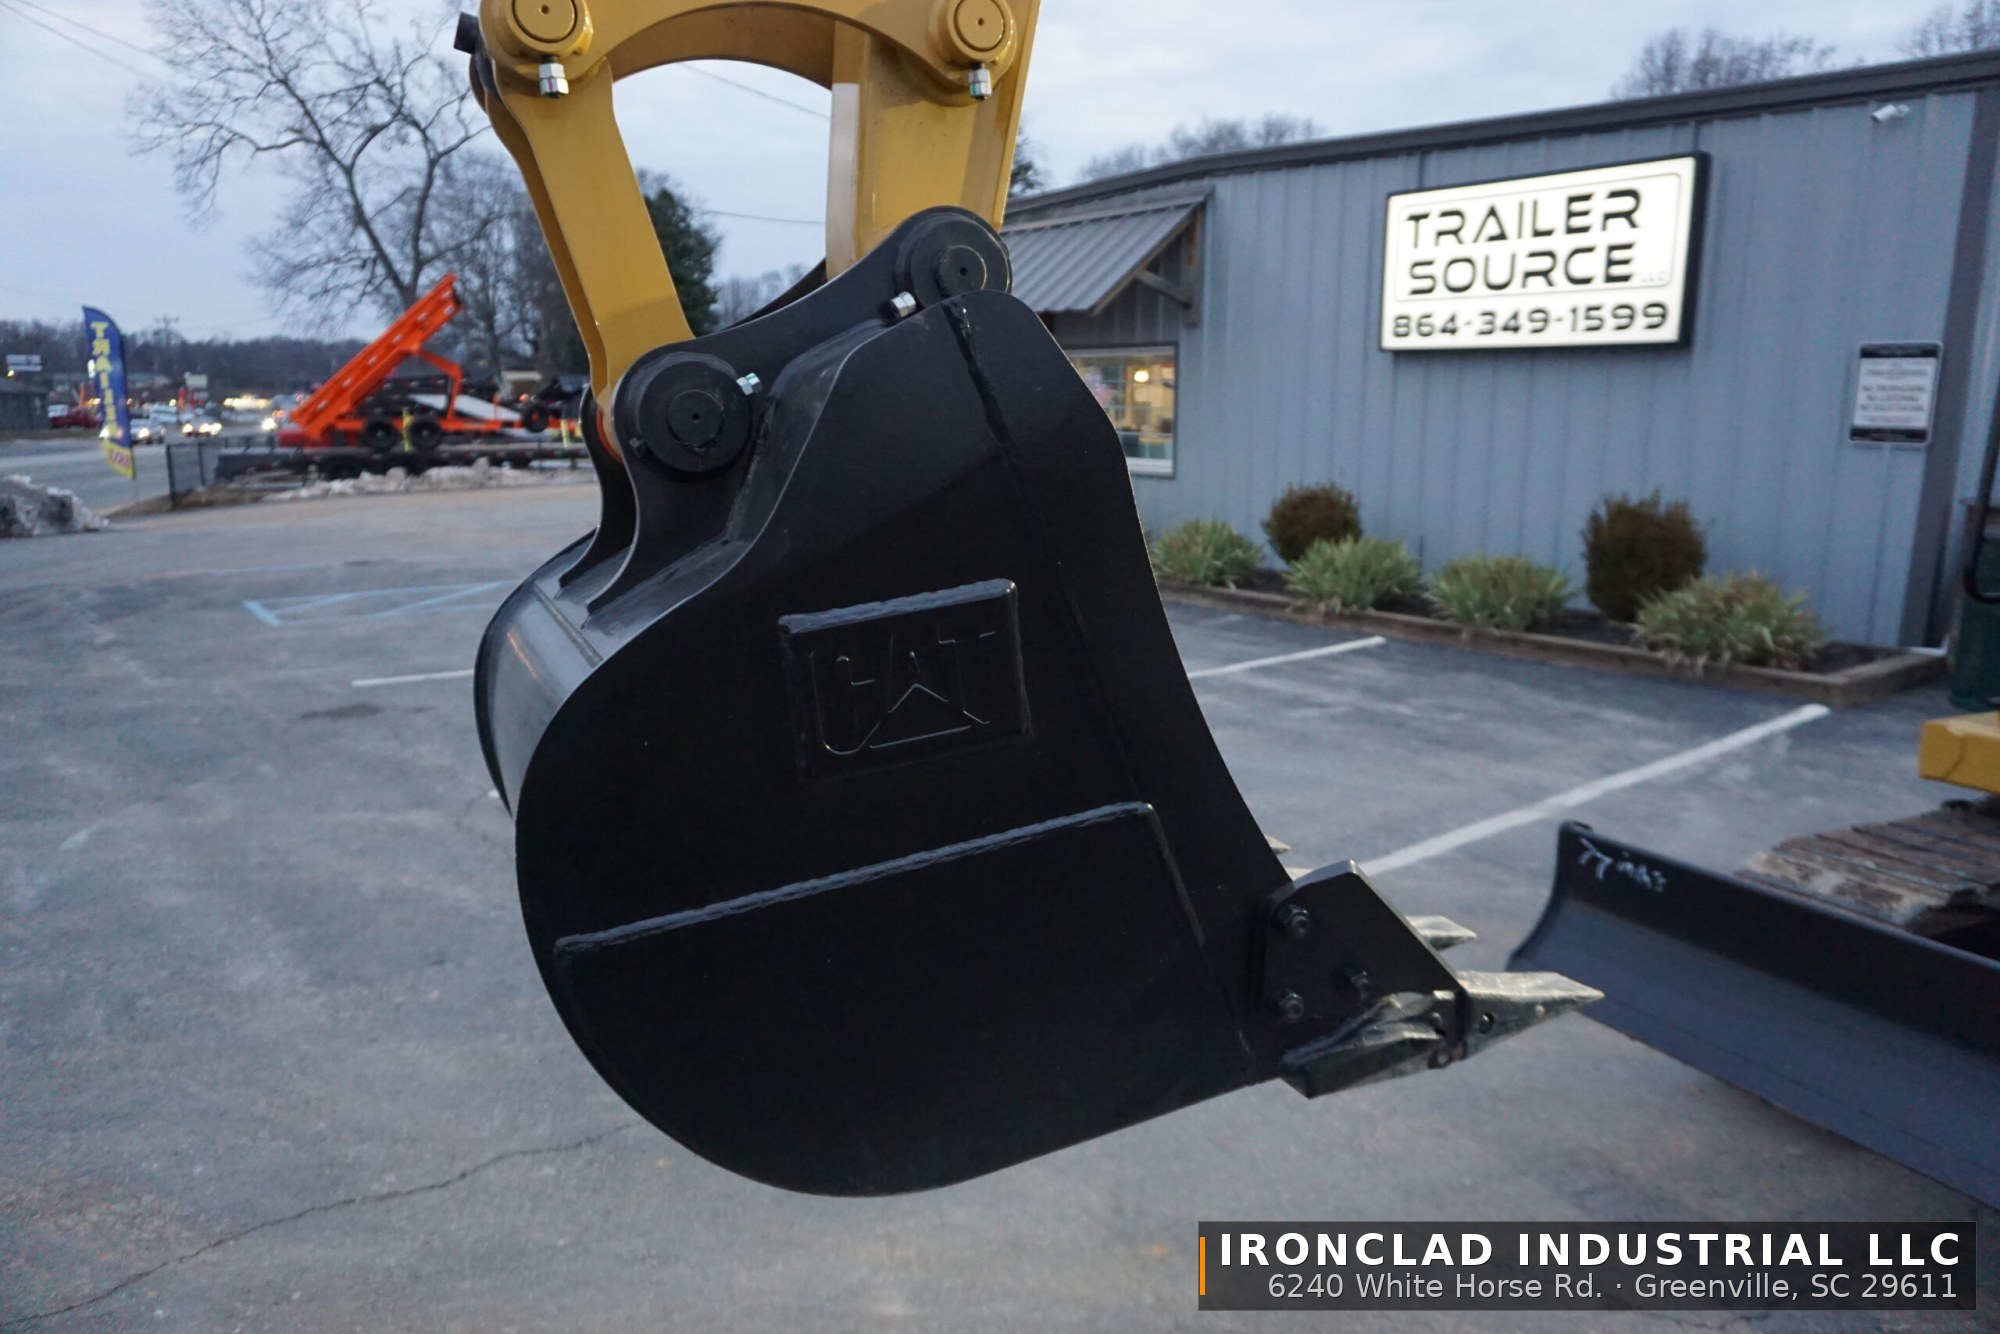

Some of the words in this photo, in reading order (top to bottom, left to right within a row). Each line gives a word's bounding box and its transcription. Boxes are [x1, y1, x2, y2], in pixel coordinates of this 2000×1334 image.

[1406, 188, 1642, 248] TRAILER
[1409, 242, 1636, 295] SOURCE
[1393, 303, 1668, 338] 864-349-1599
[807, 620, 998, 756] CAT
